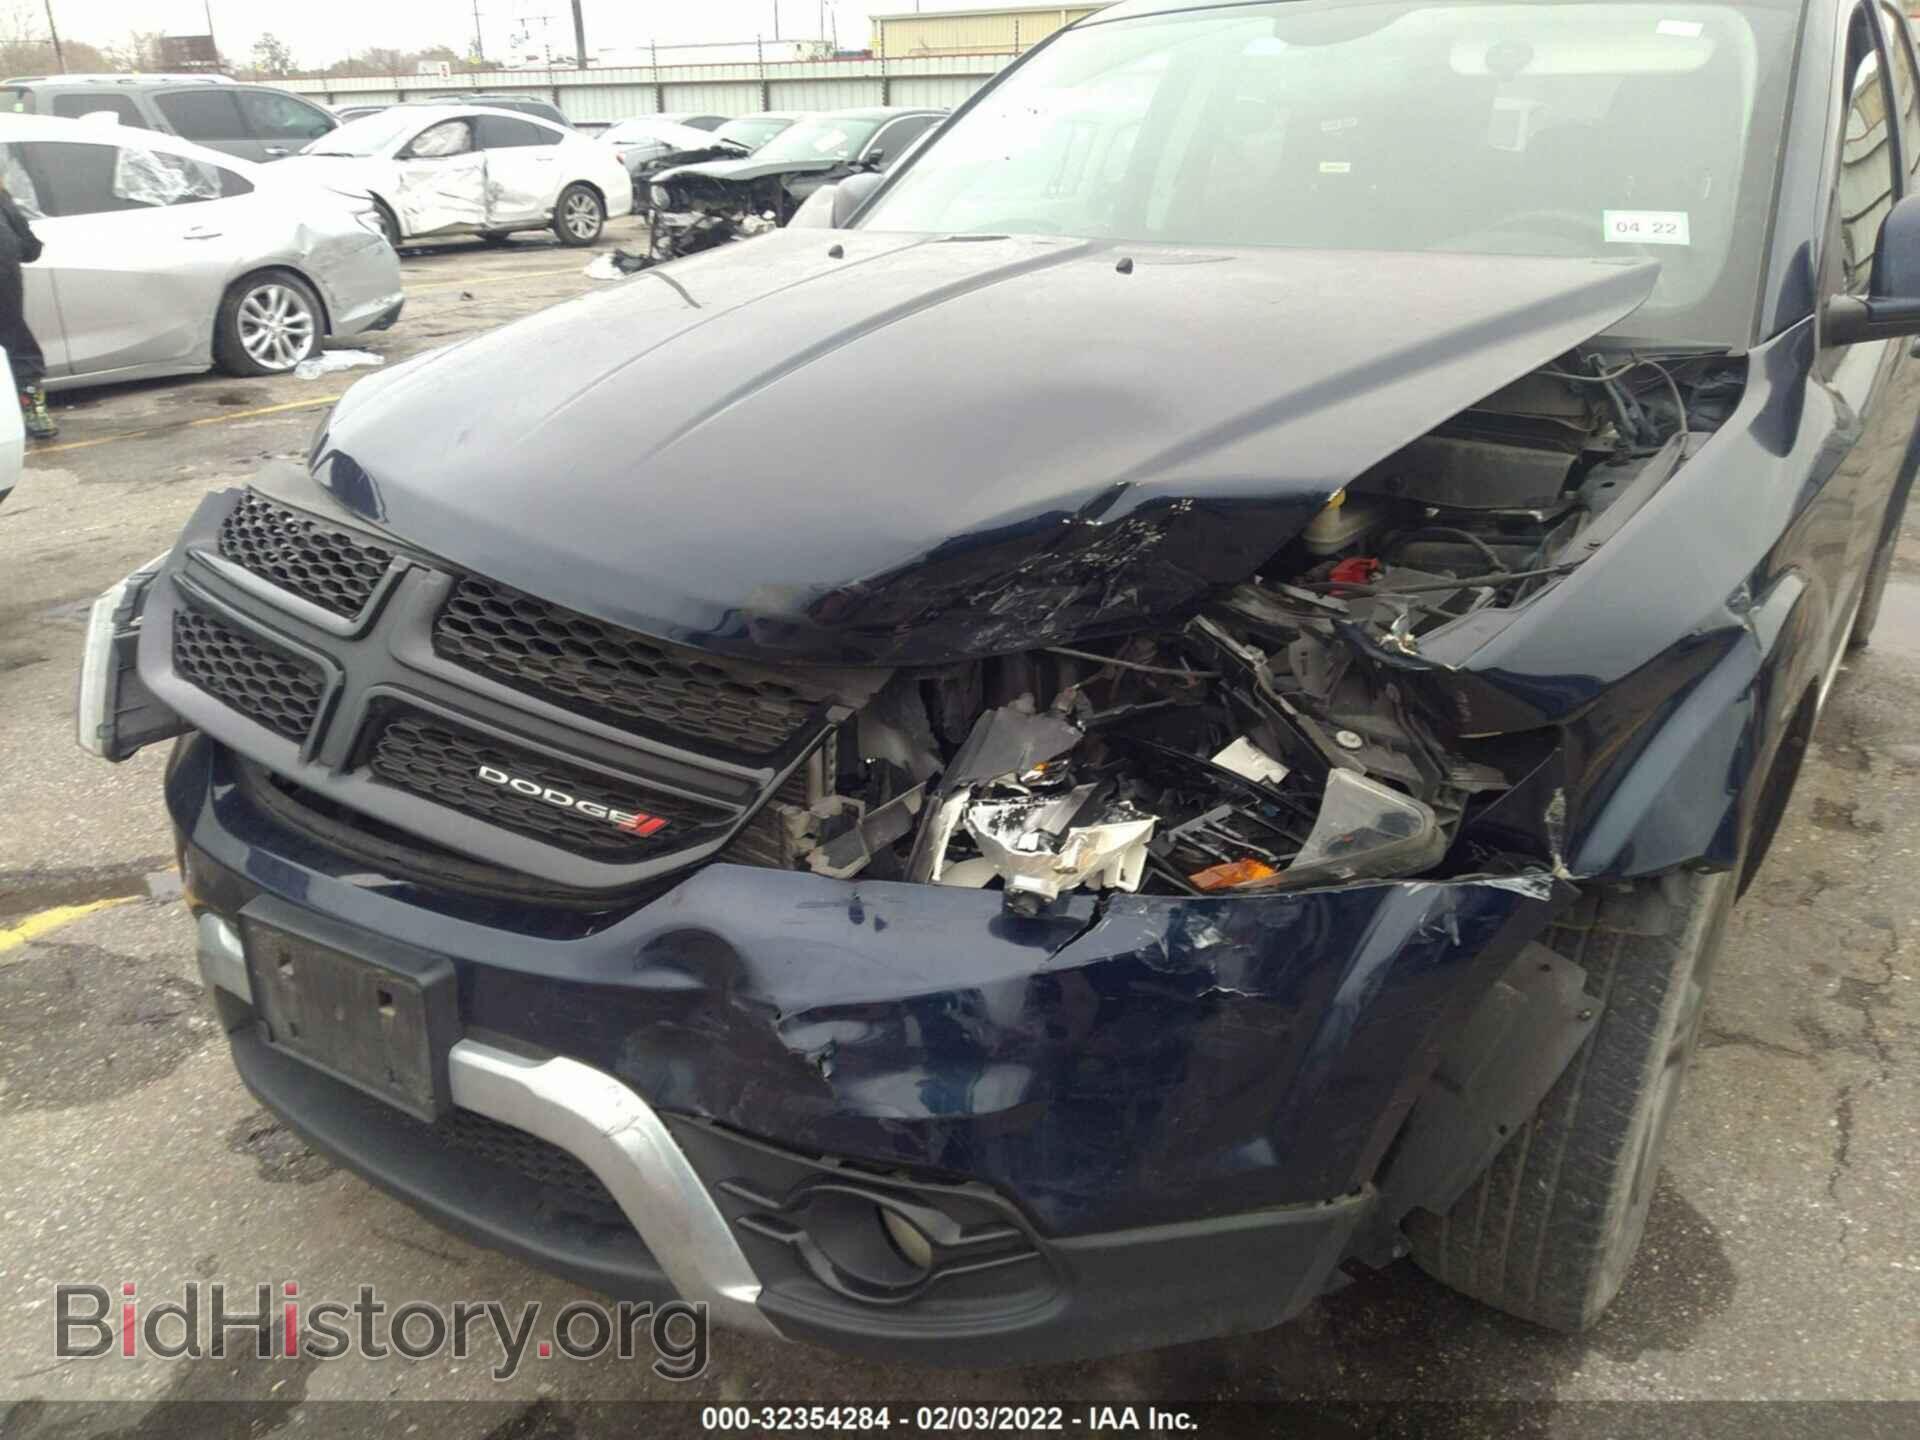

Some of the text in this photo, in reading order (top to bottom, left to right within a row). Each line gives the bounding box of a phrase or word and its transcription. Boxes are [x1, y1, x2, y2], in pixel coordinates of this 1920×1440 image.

[1615, 221, 1678, 234] 04 22
[478, 765, 641, 829] DODGE
